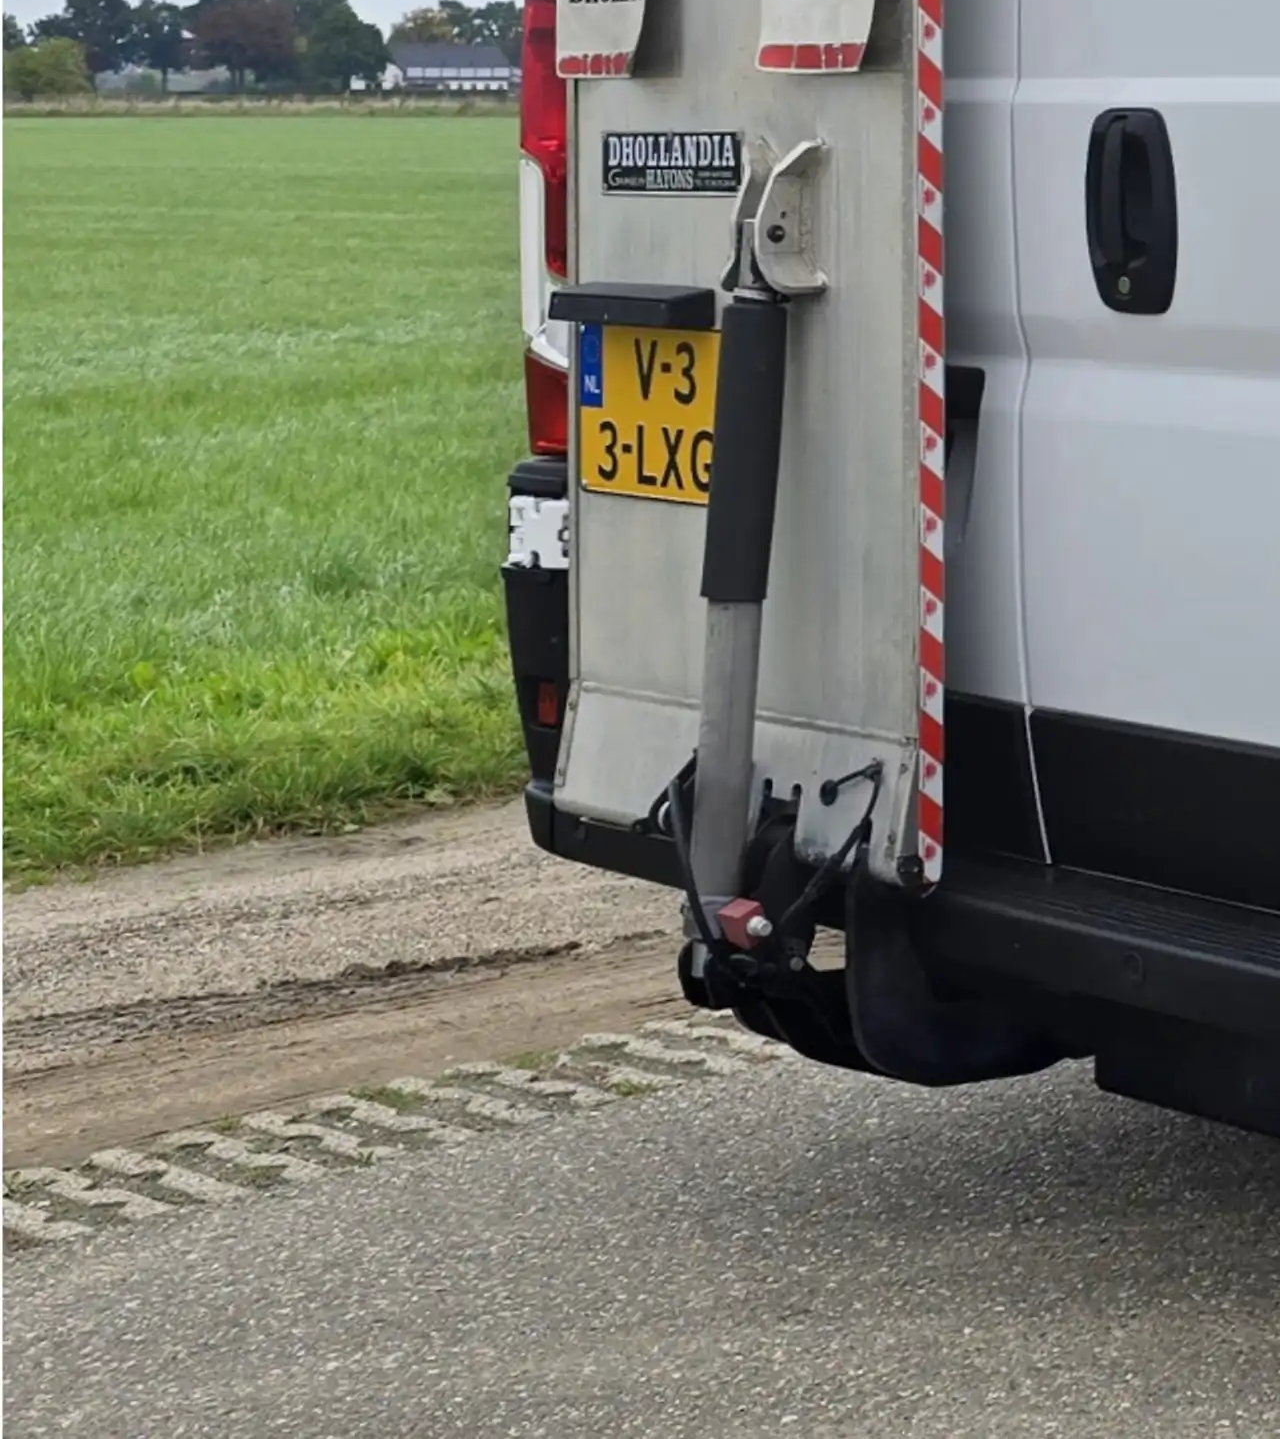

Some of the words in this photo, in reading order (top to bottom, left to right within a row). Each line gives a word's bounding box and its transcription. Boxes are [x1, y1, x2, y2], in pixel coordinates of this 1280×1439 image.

[607, 135, 735, 166] DHOLLANDIA
[584, 374, 600, 393] NL
[634, 338, 696, 405] V-3
[598, 421, 713, 492] 3-LXG
